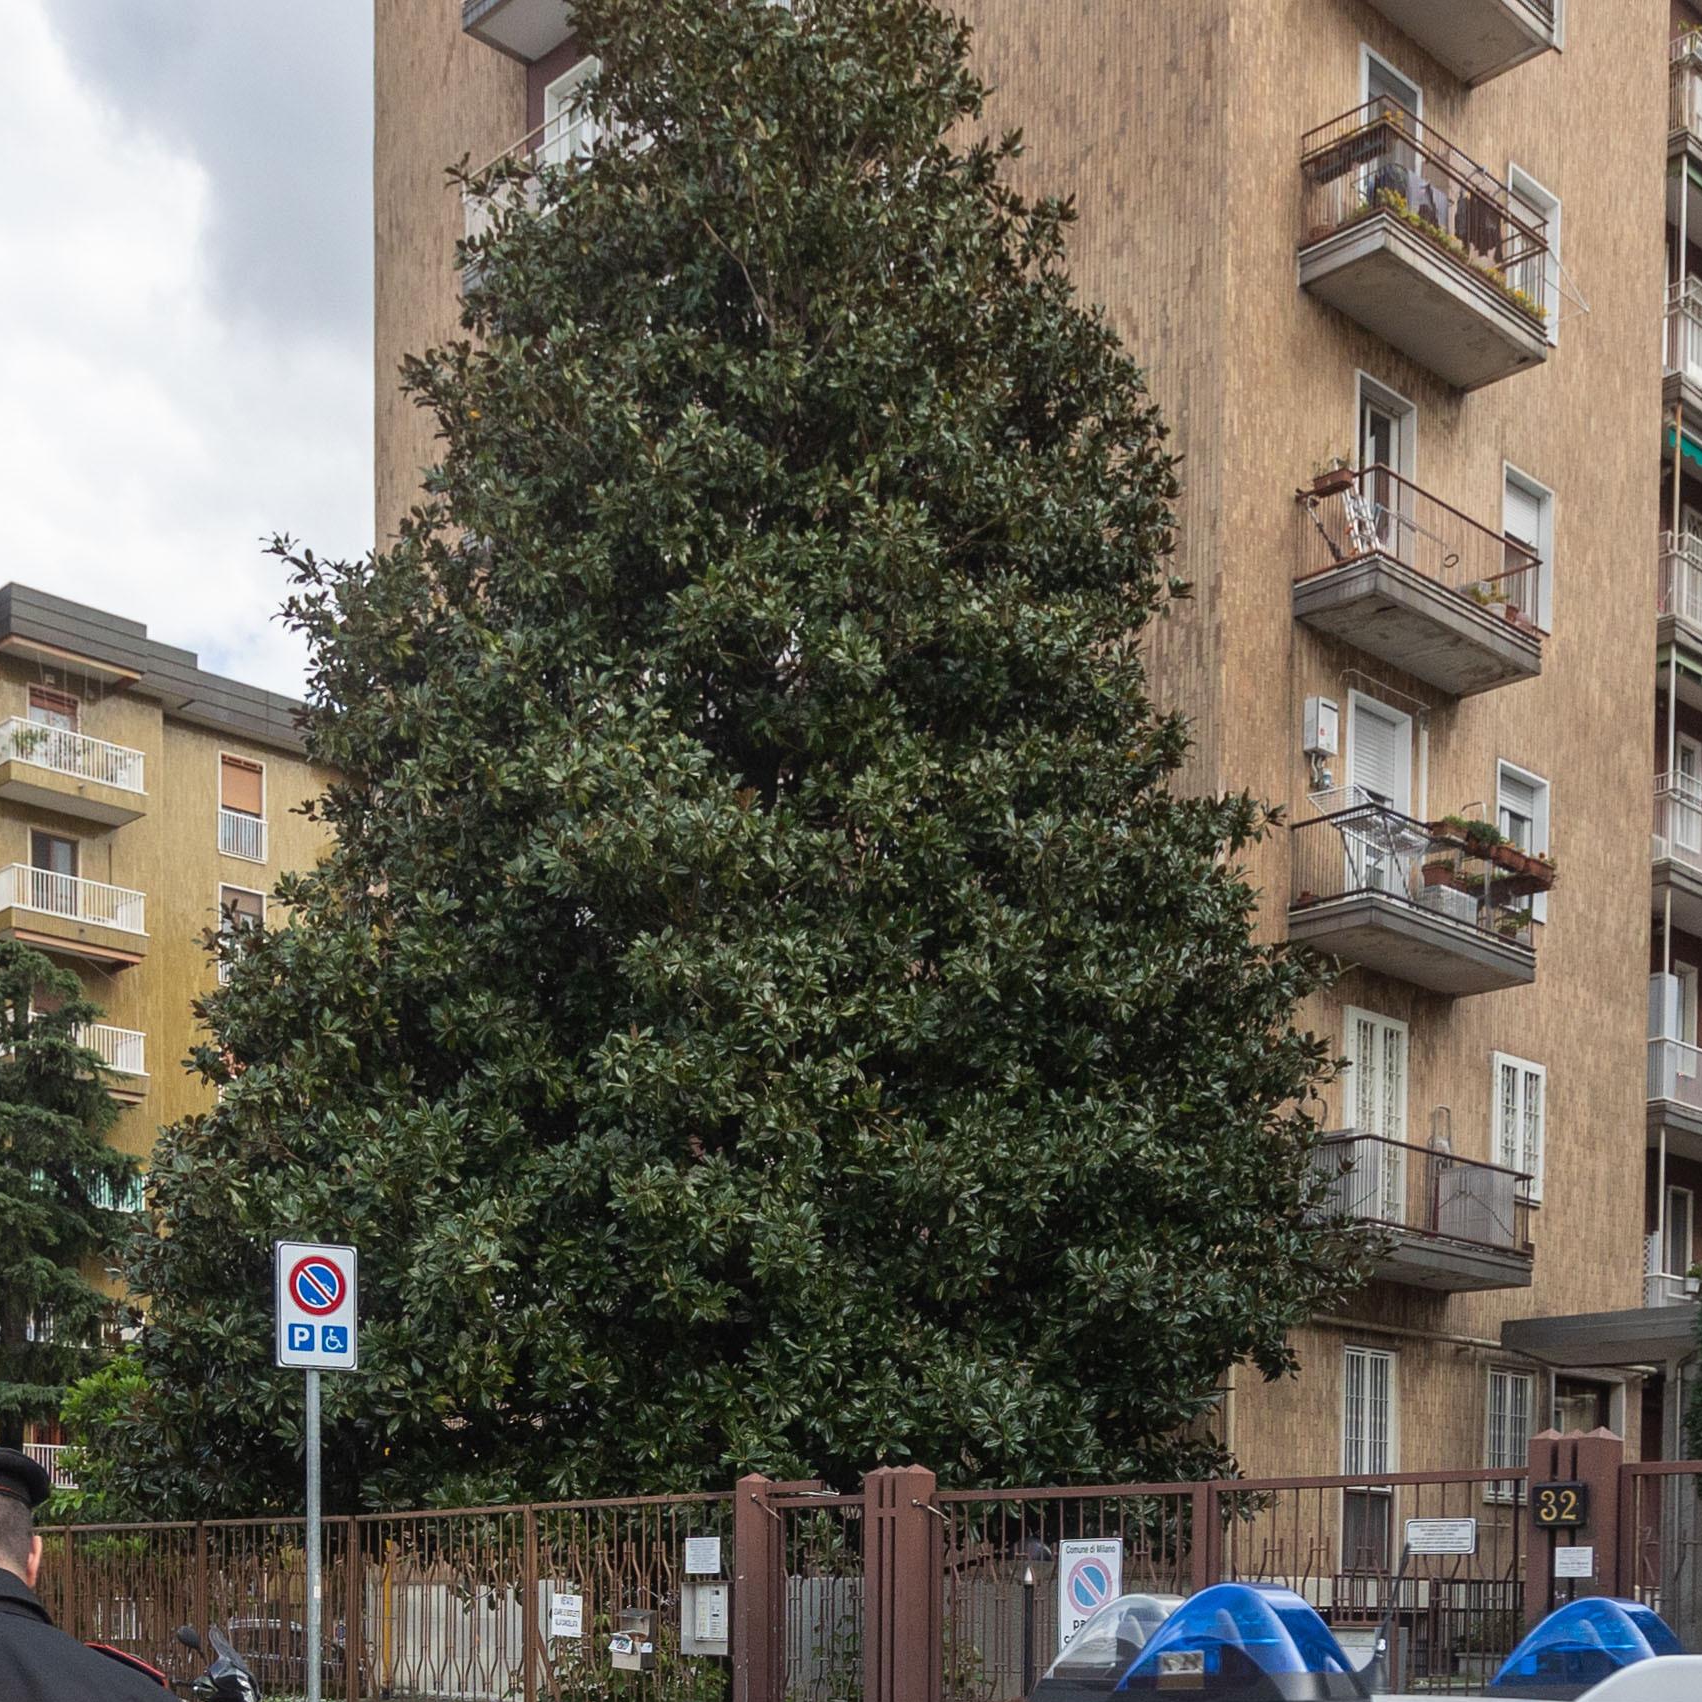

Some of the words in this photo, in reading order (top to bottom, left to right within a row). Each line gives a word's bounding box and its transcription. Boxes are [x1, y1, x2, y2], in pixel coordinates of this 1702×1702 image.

[294, 1327, 310, 1348] P
[1540, 1490, 1577, 1521] 32
[1066, 1546, 1088, 1554] Comune
[1090, 1545, 1095, 1553] di
[1097, 1545, 1116, 1553] Milano
